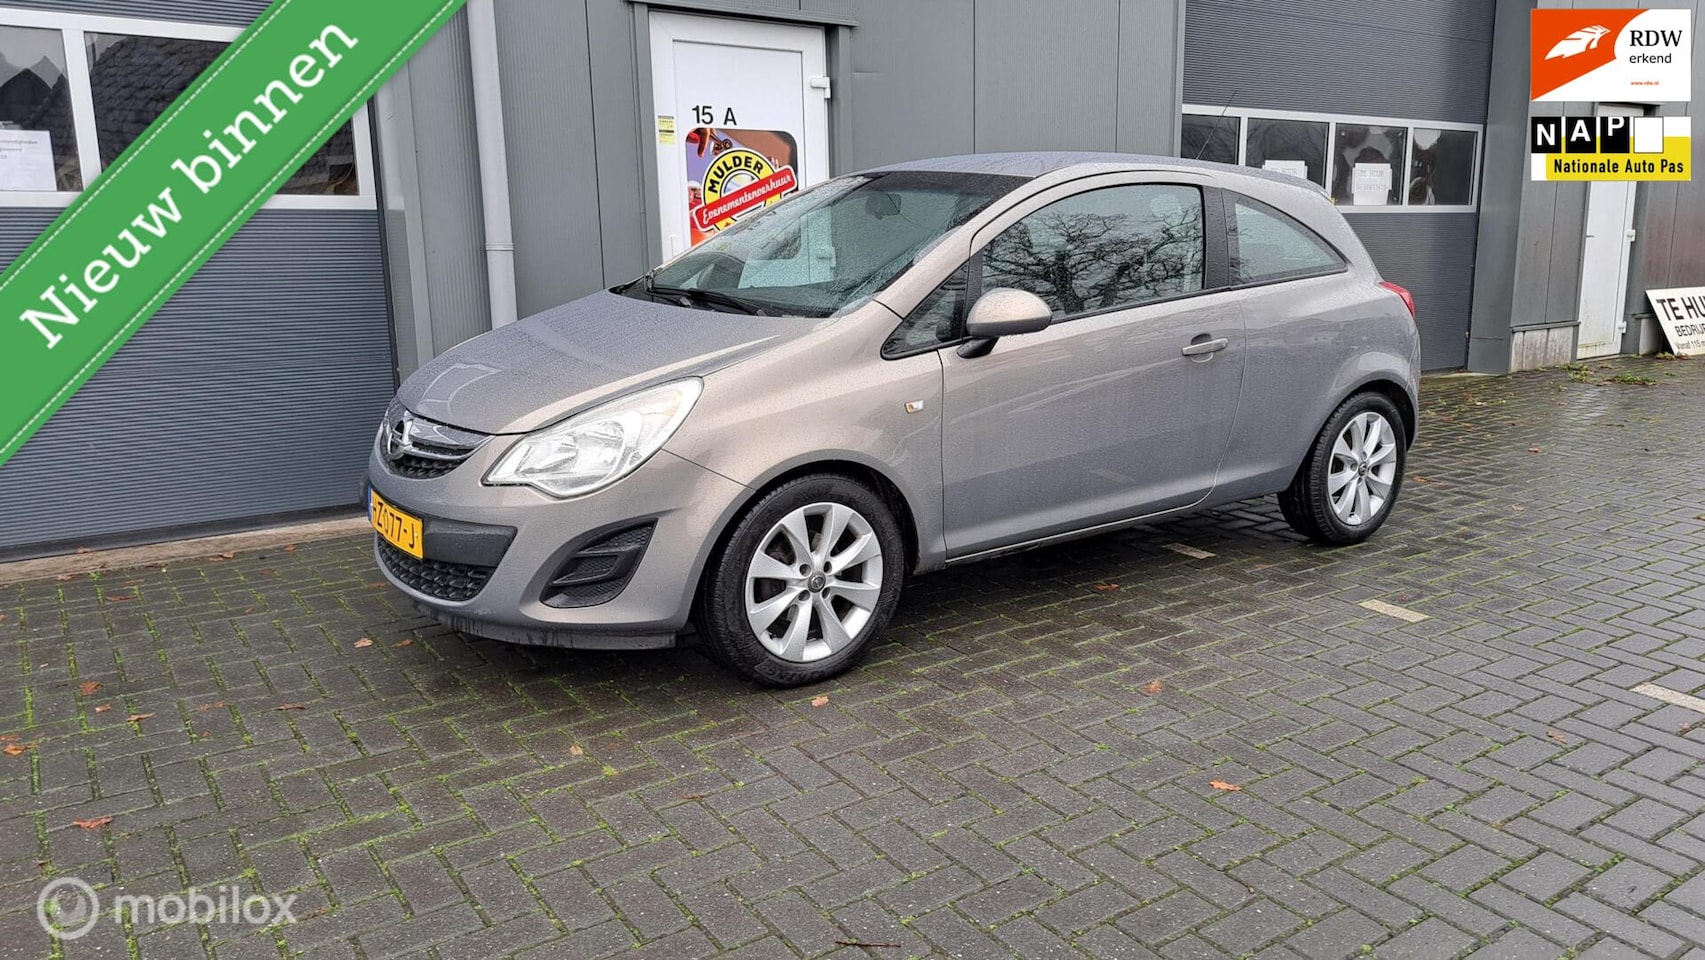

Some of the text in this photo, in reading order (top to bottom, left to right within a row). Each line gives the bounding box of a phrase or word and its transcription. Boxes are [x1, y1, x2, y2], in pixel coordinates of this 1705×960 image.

[692, 105, 738, 126] 15 A
[708, 156, 764, 194] MULDER
[702, 174, 793, 225] Evenementenverhuur
[1656, 295, 1705, 321] TE HU
